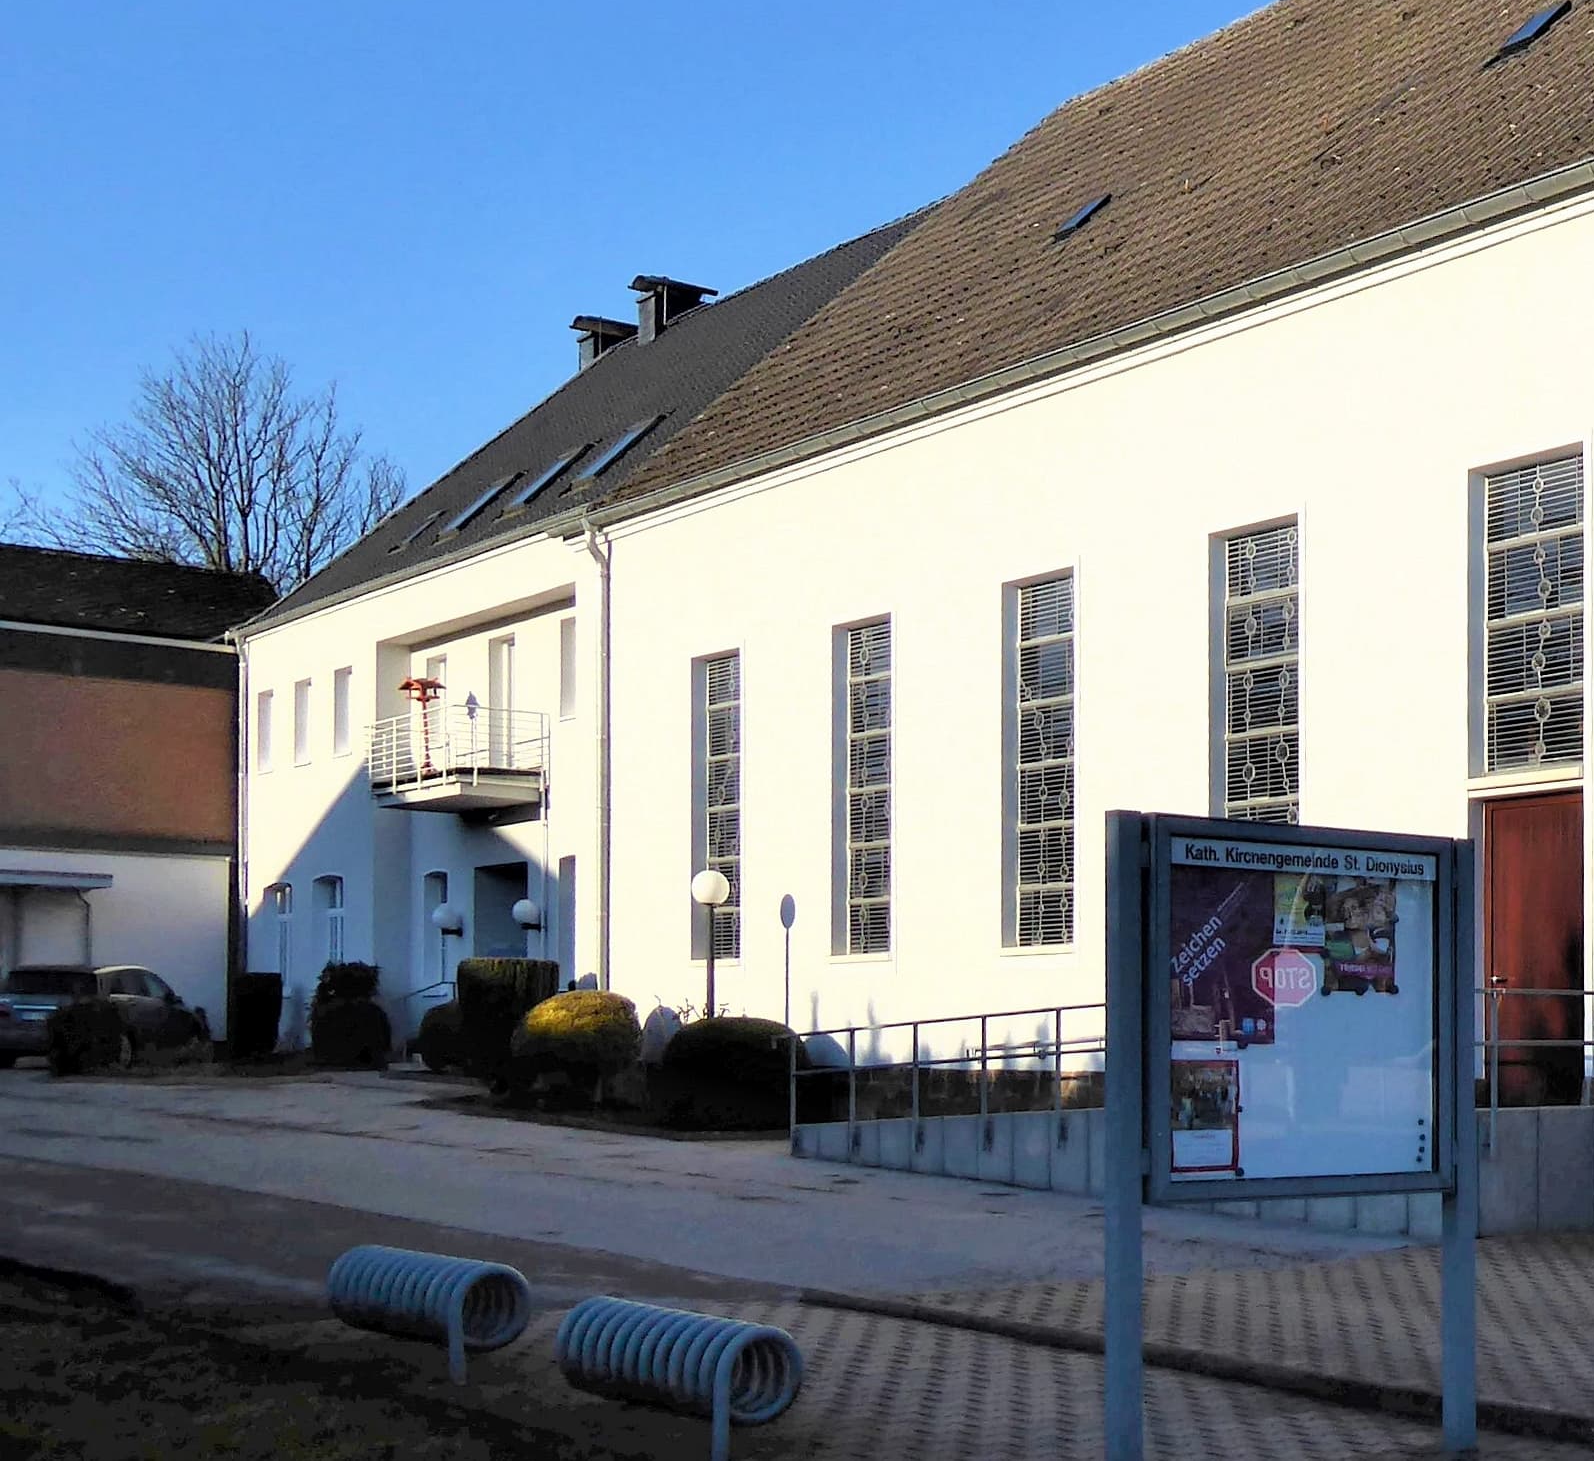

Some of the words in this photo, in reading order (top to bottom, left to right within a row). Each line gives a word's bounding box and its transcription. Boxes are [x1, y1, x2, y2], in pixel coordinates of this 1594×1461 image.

[1185, 843, 1219, 862] Kath.
[1225, 846, 1339, 869] Kirchengemeinde
[1344, 854, 1361, 871] St.
[1366, 856, 1425, 876] Dionysius
[1183, 937, 1227, 987] setzen
